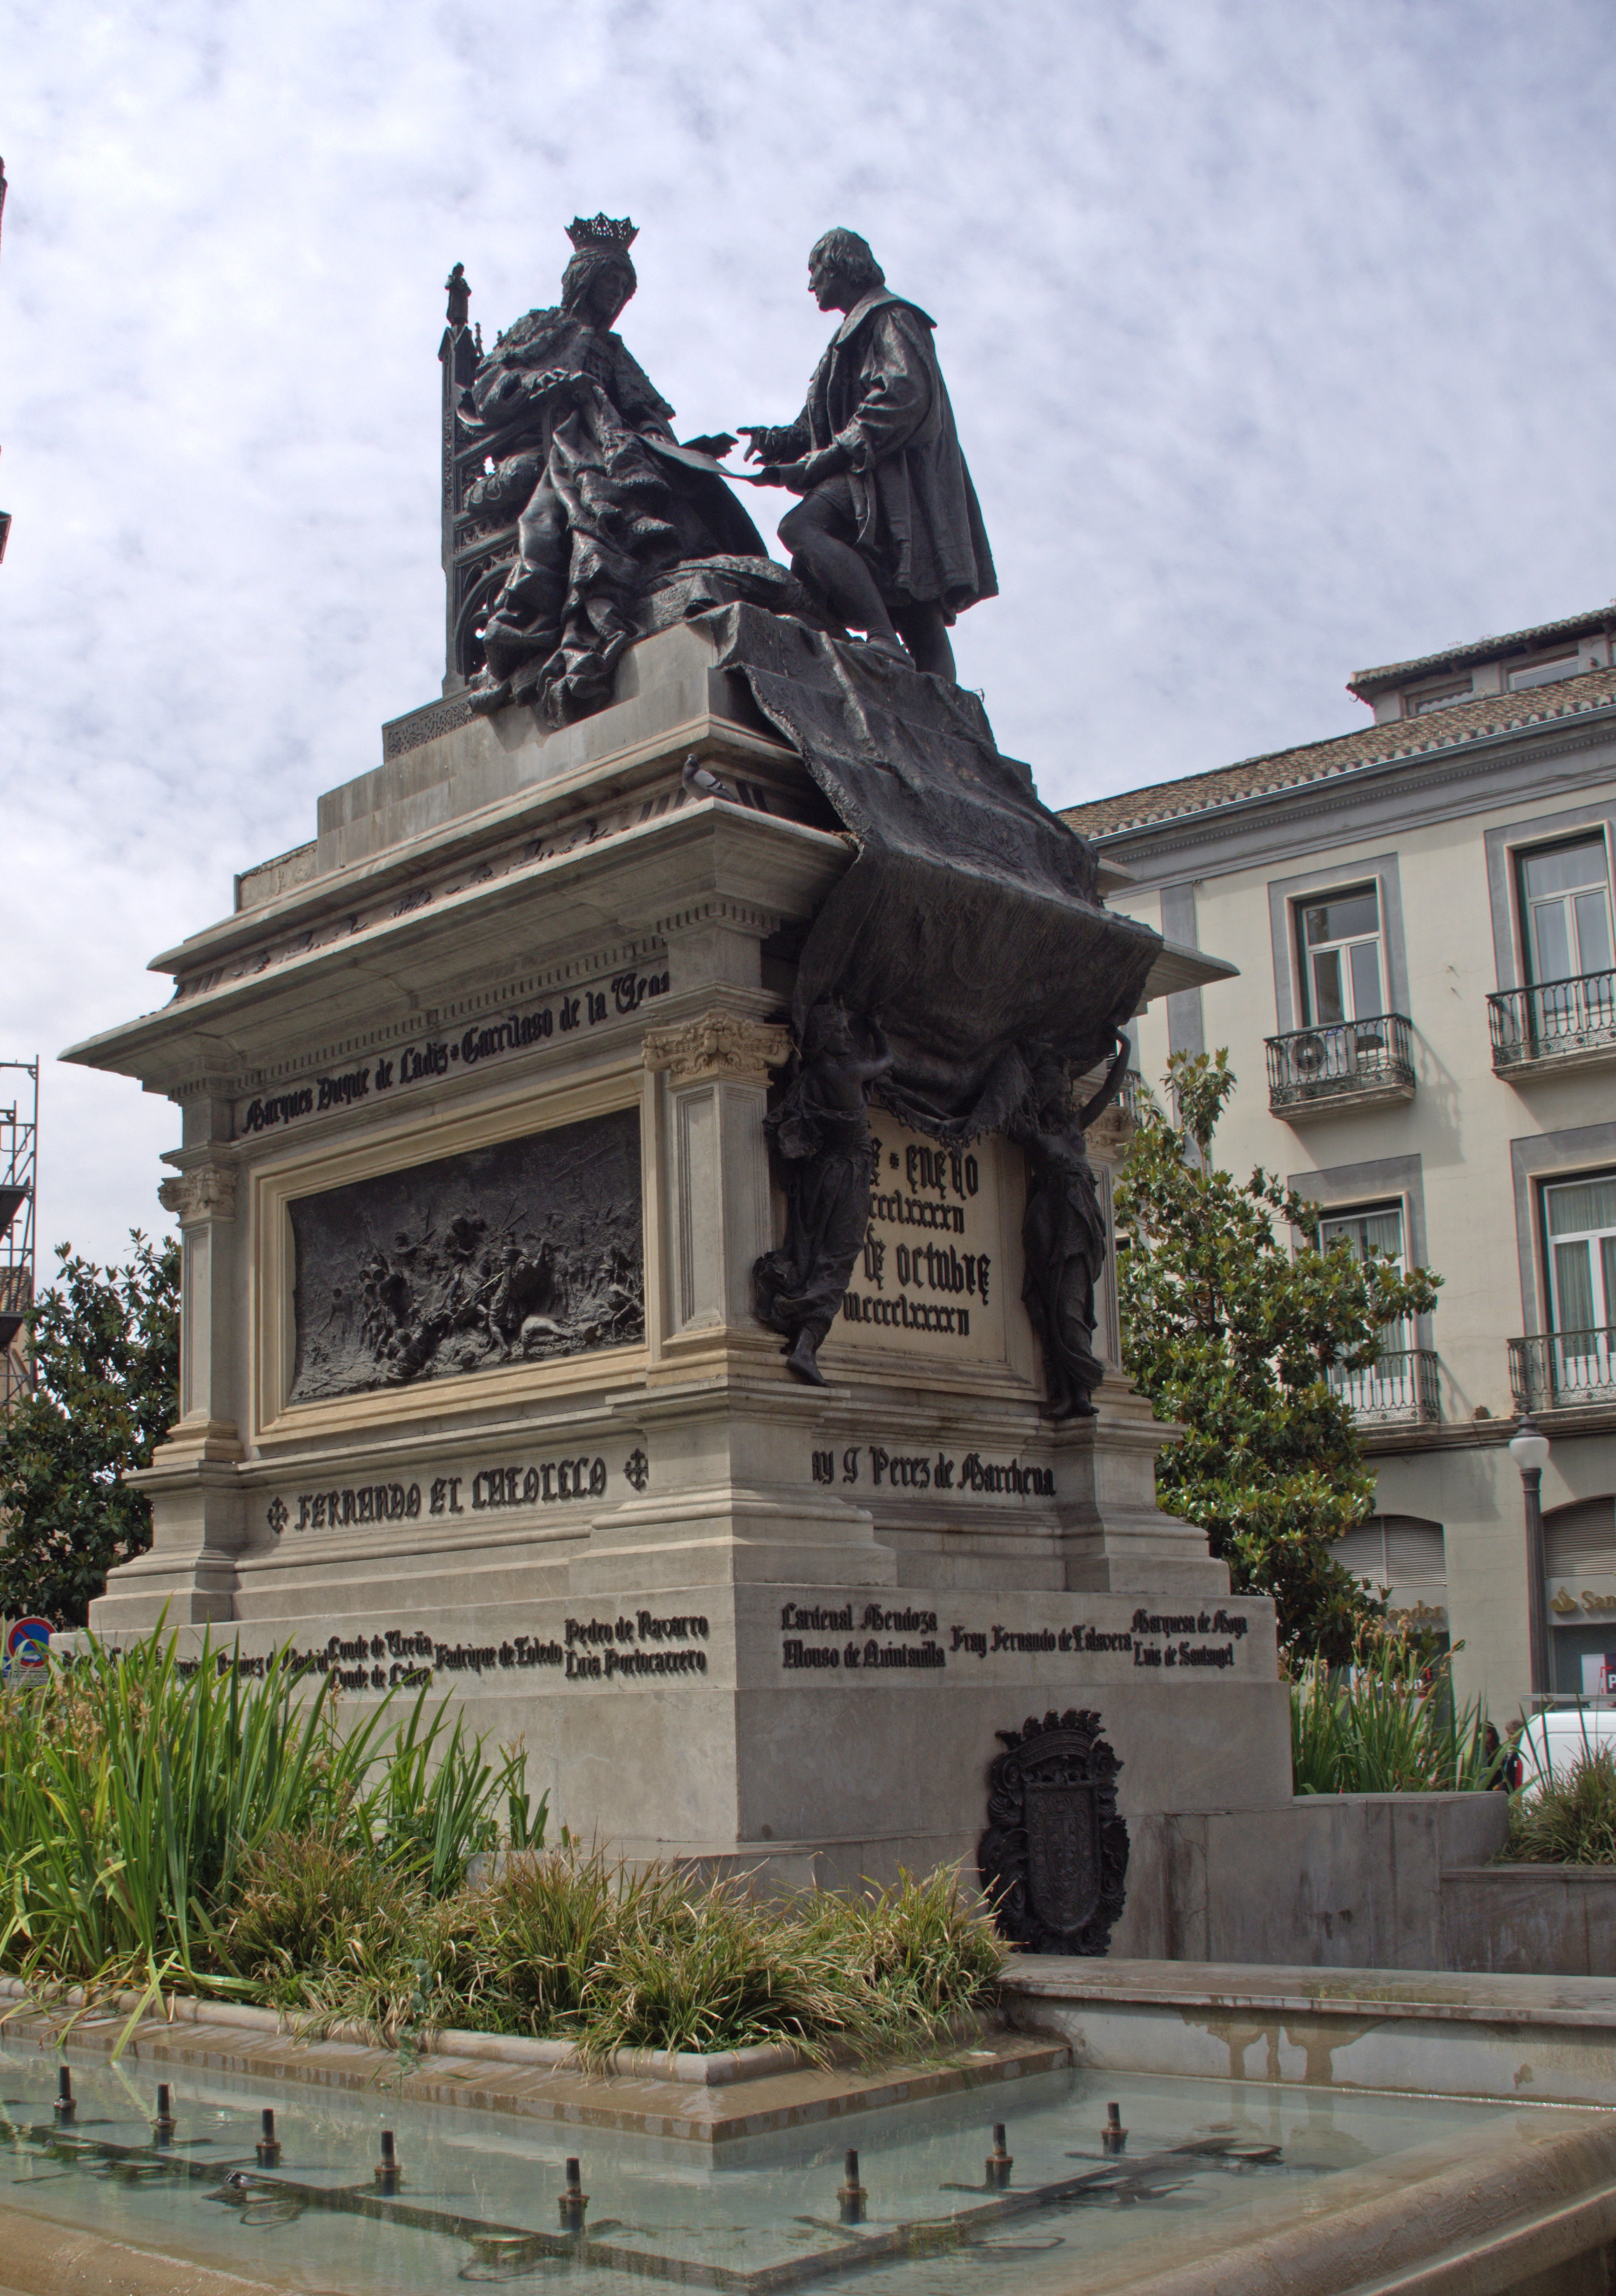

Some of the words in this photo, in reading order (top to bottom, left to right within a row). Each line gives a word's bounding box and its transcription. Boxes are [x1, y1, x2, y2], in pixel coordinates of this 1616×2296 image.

[242, 1088, 313, 1133] Marques
[317, 1068, 370, 1111] Duque
[375, 1058, 393, 1090] de
[400, 1042, 448, 1084] Cadiz
[461, 1008, 553, 1064] Garcilaso
[559, 996, 580, 1031] de
[585, 991, 608, 1025] la
[897, 1242, 991, 1306] octubre
[869, 1446, 930, 1488] Perez
[935, 1452, 954, 1488] de
[957, 1452, 1057, 1496] Marchena
[294, 1483, 421, 1529] FERNANDO
[430, 1477, 462, 1514] EL
[472, 1457, 606, 1508] CATOLICO
[782, 1603, 854, 1630] Cardenal
[860, 1603, 938, 1634] Mendoza
[1130, 1608, 1196, 1638] Marquesa
[1198, 1610, 1211, 1633] de
[1212, 1610, 1248, 1639] Moya
[1386, 1599, 1444, 1620] ander
[564, 1617, 613, 1645] Pedro
[614, 1615, 634, 1641] de
[635, 1610, 709, 1640] Navarro
[950, 1625, 987, 1658] Fray
[990, 1624, 1056, 1651] Fernando
[1058, 1627, 1072, 1651] de
[1072, 1624, 1133, 1651] Talavera
[328, 1635, 369, 1659] Conde
[370, 1634, 386, 1657] de
[433, 1643, 497, 1672] Fadrique
[498, 1640, 515, 1666] de
[514, 1635, 563, 1664] Toledo
[783, 1640, 840, 1668] Alonso
[844, 1641, 861, 1667] de
[863, 1639, 946, 1667] Quintanilla
[1134, 1641, 1162, 1666] Luis
[1165, 1645, 1177, 1666] de
[1179, 1641, 1235, 1668] Santangel
[371, 1664, 387, 1687] de
[564, 1648, 601, 1677] Luis
[604, 1648, 707, 1675] Portocarrero
